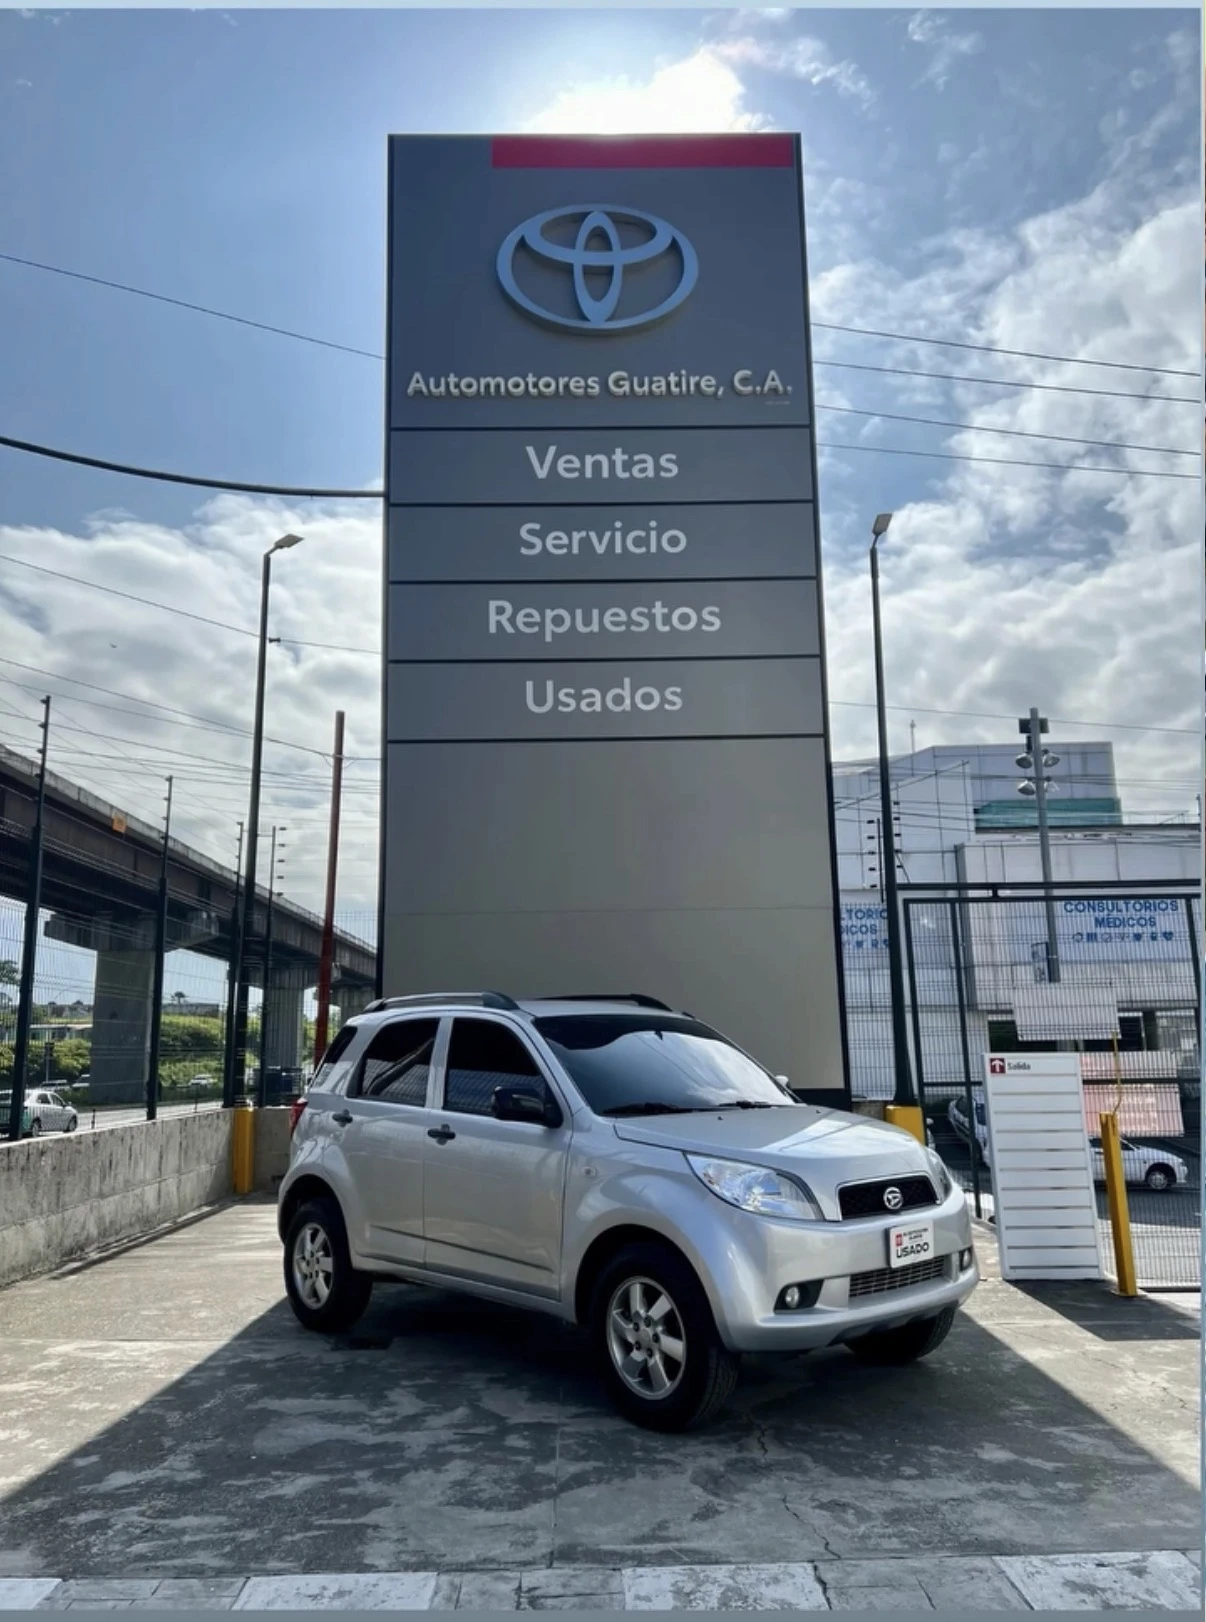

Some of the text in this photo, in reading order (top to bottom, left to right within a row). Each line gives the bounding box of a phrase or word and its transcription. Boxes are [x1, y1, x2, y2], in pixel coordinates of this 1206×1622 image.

[407, 369, 793, 399] Automotores Guatire, C.A.
[526, 446, 679, 479] Ventas
[519, 521, 687, 555] Servicio
[488, 600, 721, 642] Repuestos
[525, 677, 683, 713] Usados
[1063, 900, 1179, 913] CONSULTORIOS
[1007, 1061, 1031, 1071] Salida
[896, 1242, 929, 1258] USADO
